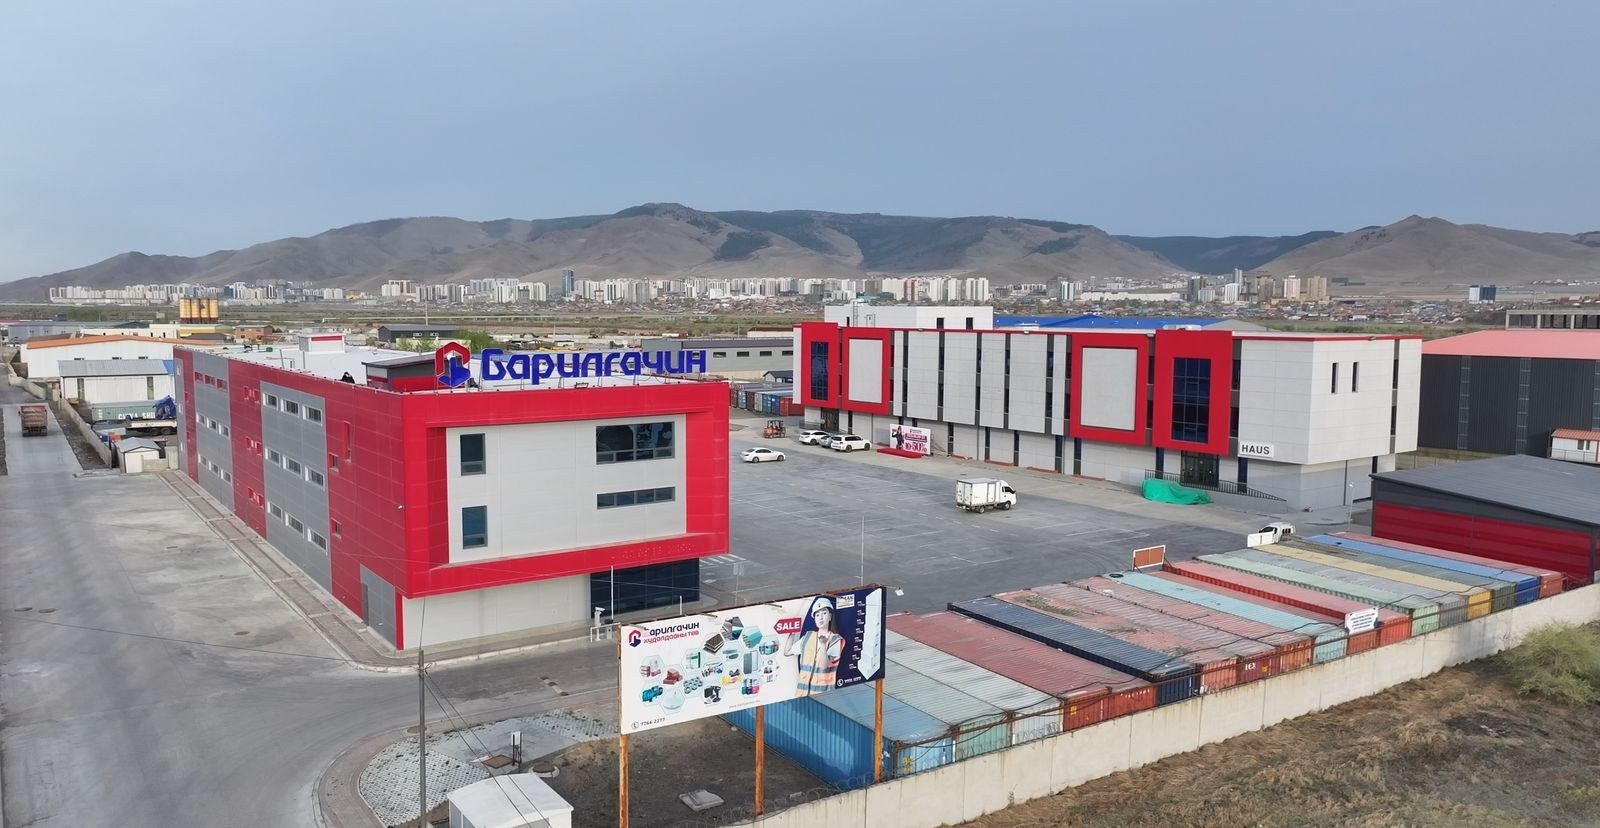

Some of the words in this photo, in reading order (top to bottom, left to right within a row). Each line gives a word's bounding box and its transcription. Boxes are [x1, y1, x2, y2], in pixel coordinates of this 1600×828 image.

[482, 349, 707, 385] Барилгачин
[1241, 444, 1270, 455] HAUS
[776, 620, 800, 631] SALE
